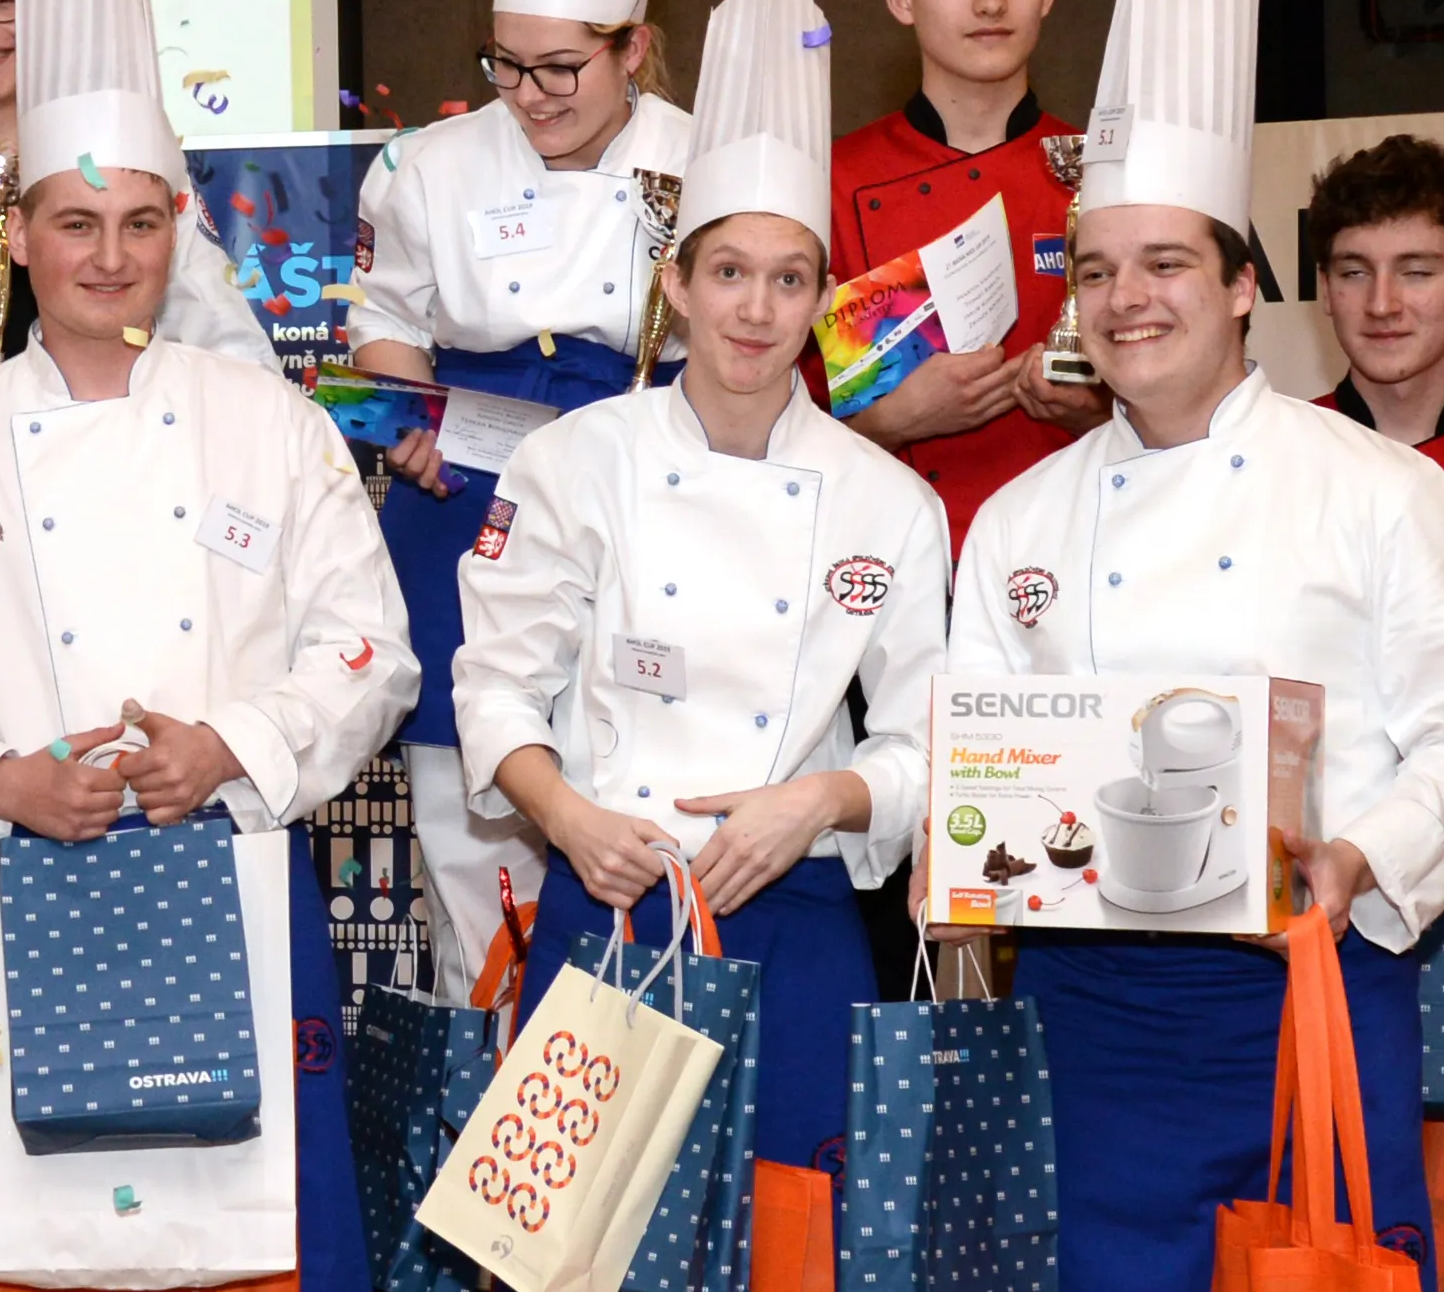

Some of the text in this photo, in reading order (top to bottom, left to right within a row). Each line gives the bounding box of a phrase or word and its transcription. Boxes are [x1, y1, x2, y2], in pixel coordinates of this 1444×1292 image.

[499, 222, 526, 241] 5.4
[1034, 250, 1065, 270] AHO
[237, 242, 355, 308] ÁŠT
[823, 281, 907, 329] DIPLOM
[272, 321, 329, 342] koná
[277, 349, 317, 369] vně
[224, 525, 251, 549] 5.3
[636, 659, 662, 679] 5.2
[950, 692, 1103, 719] SENCOR
[950, 747, 1062, 765] Hand Mixer
[950, 766, 1021, 779] with Bowl
